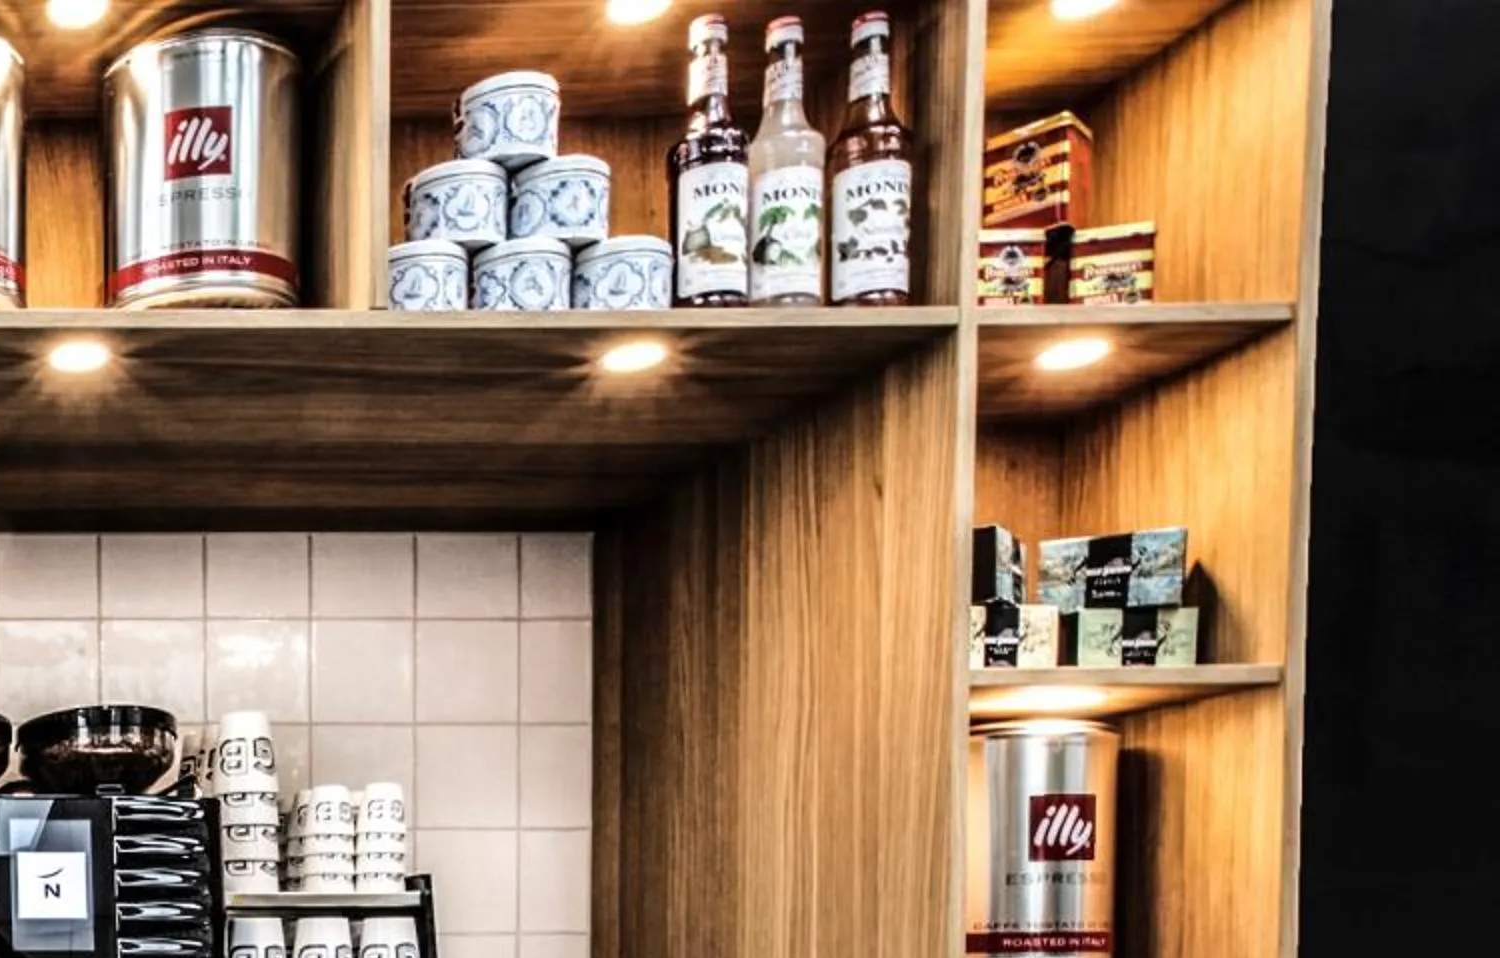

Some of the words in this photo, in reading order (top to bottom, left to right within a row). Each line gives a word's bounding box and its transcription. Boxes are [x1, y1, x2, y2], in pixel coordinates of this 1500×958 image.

[168, 117, 228, 170] illy
[694, 183, 743, 199] MON
[762, 186, 818, 204] MONI
[202, 256, 215, 266] IN
[217, 255, 252, 266] ITALY
[1033, 804, 1093, 856] illy
[44, 884, 61, 898] N
[1003, 937, 1066, 948] ROASTED
